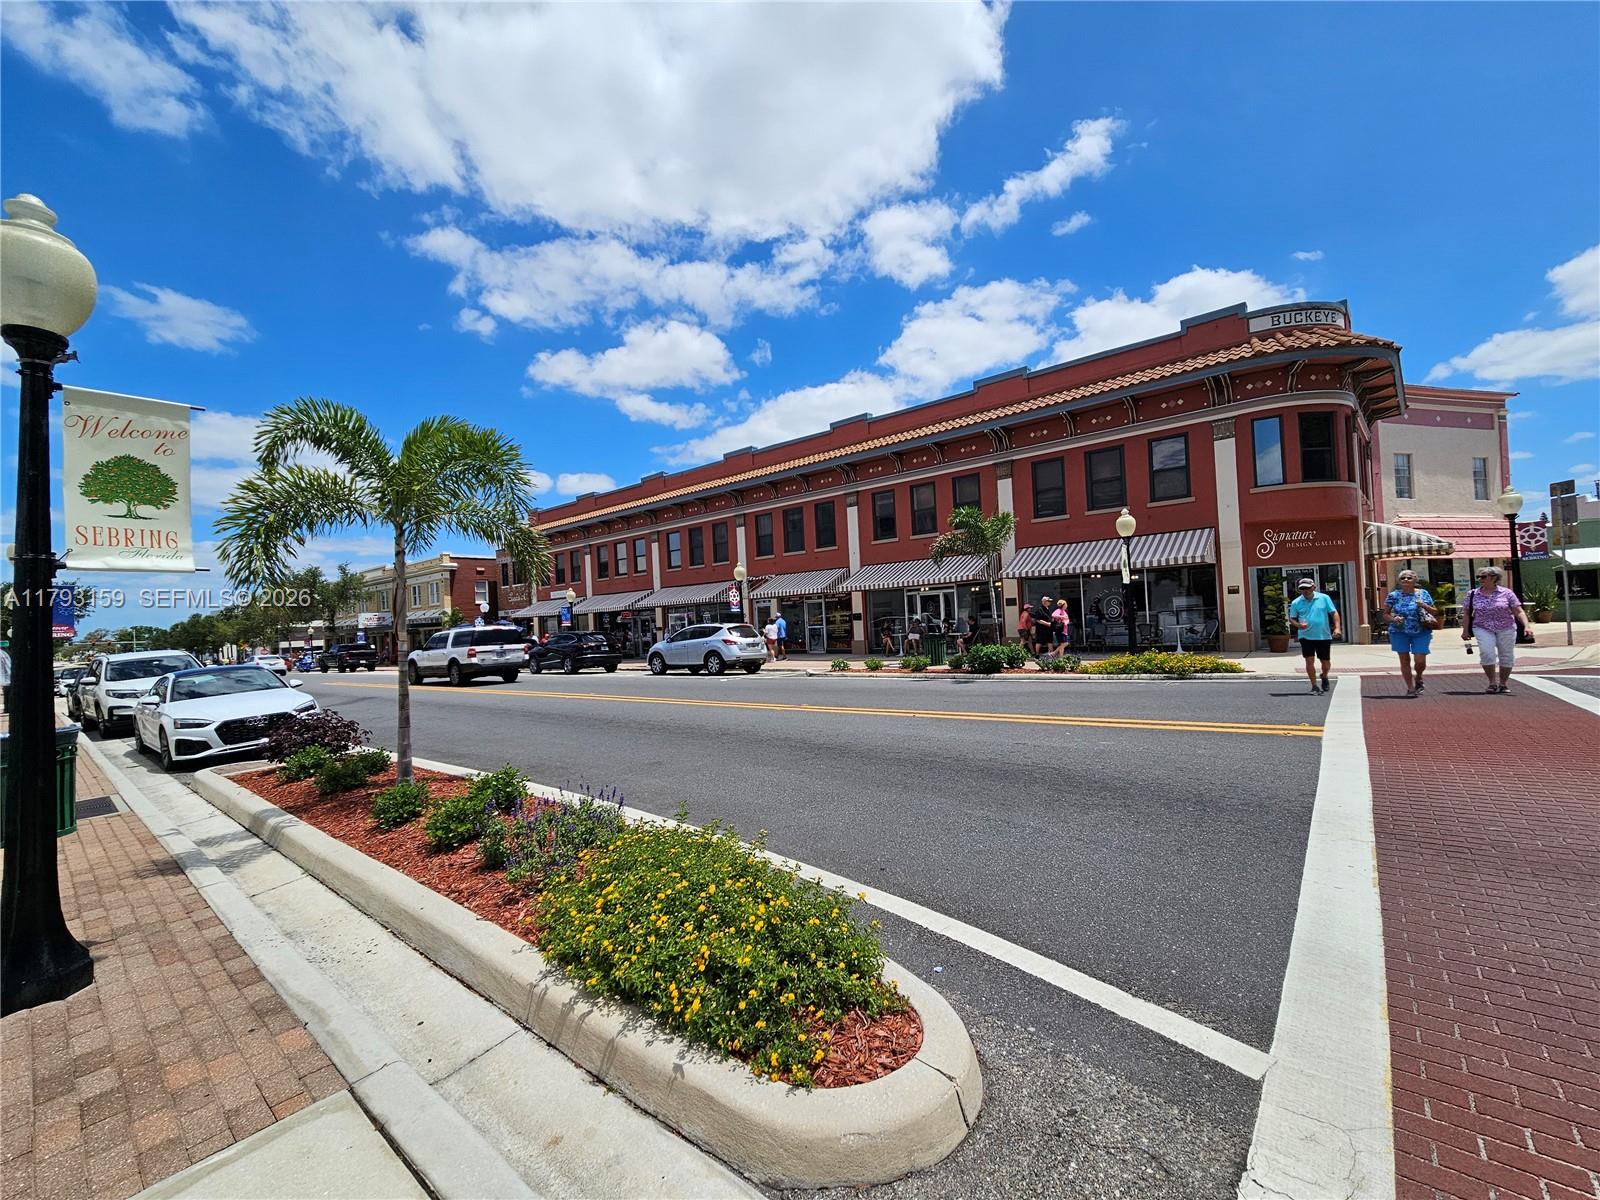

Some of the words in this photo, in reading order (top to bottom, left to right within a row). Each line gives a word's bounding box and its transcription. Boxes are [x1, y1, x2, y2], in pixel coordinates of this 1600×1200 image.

[1270, 311, 1337, 327] BUCKEYE
[63, 414, 189, 440] Welcome
[153, 441, 176, 457] to
[75, 525, 178, 549] SEBRING
[1256, 528, 1317, 559] Signature
[118, 547, 184, 560] Florida
